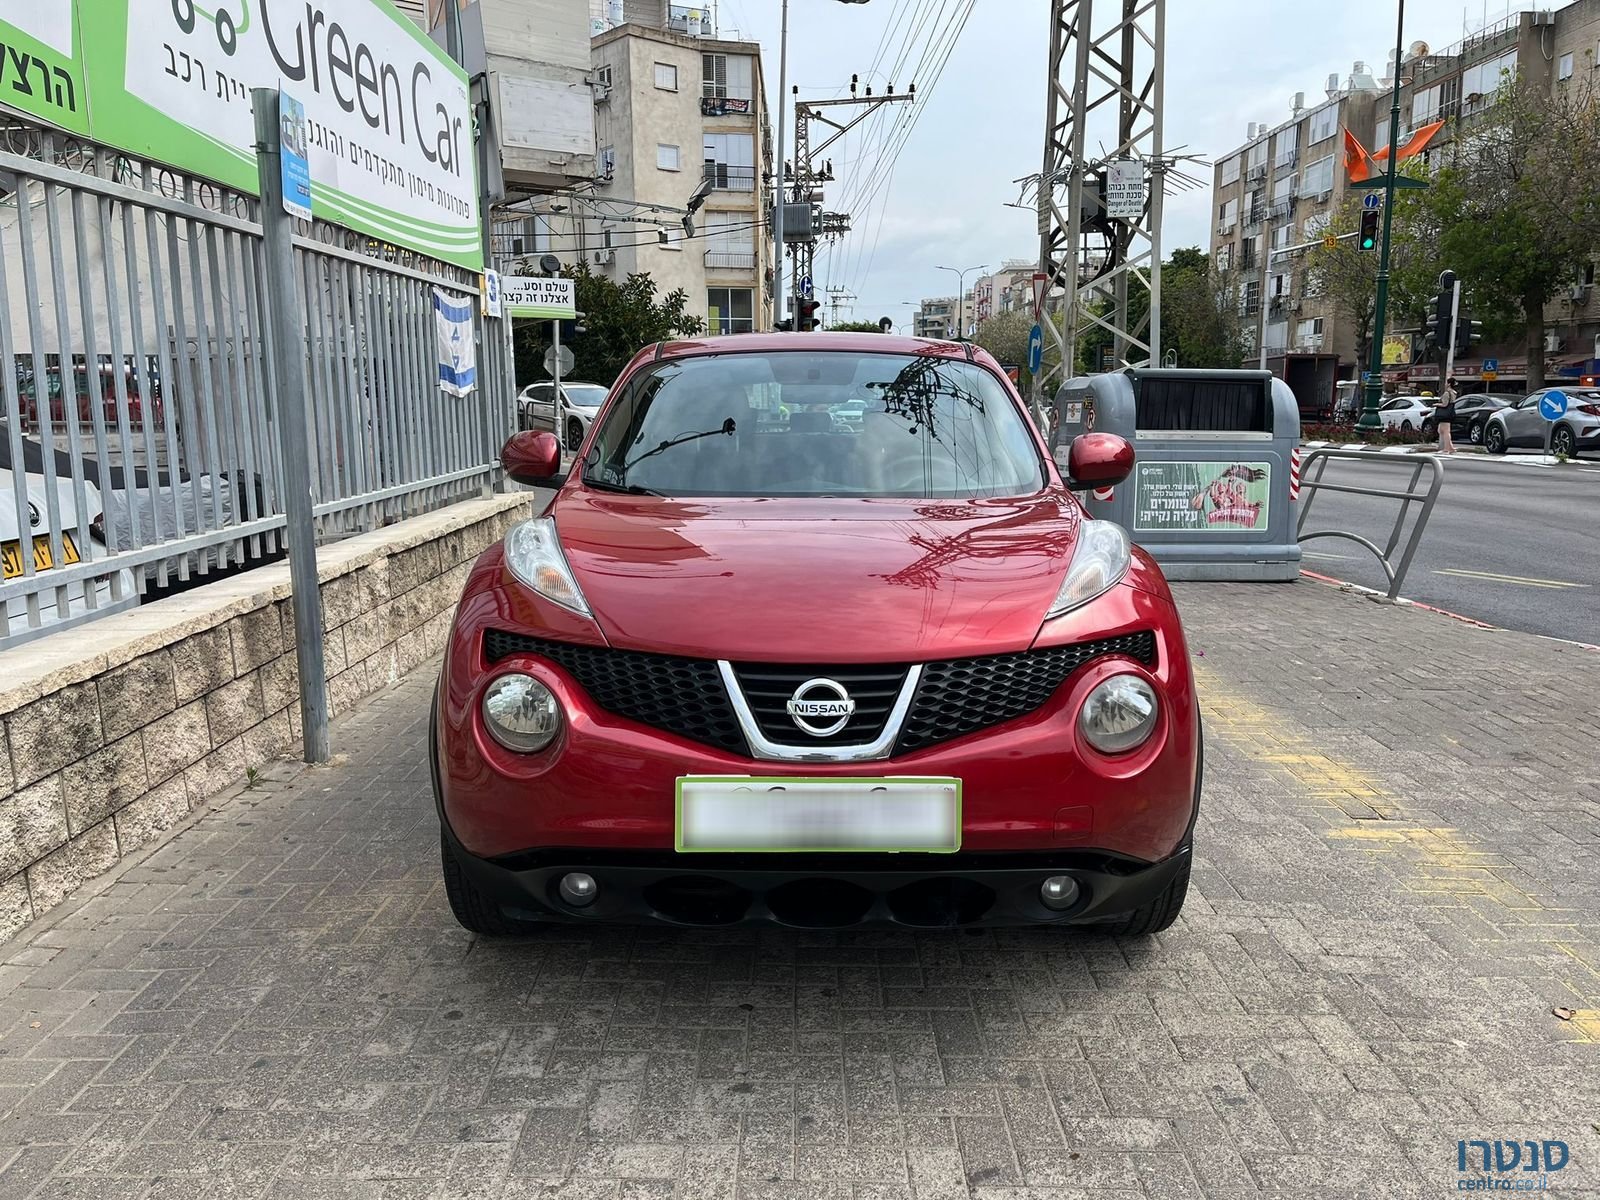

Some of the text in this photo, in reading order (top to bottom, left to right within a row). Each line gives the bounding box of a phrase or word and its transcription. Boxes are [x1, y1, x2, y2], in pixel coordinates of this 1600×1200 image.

[163, 43, 206, 91] רכב
[216, 70, 252, 102] יית
[411, 61, 462, 177] Car
[308, 119, 344, 158] והוגנ
[350, 141, 405, 188] מתקדמים
[408, 172, 434, 202] מימון
[437, 188, 470, 219] פתרונות
[1325, 237, 1335, 247] 13
[513, 281, 568, 292] שלם וסע...
[503, 292, 569, 304] אצלנו זה קצר
[1150, 498, 1189, 509] שומרים
[1140, 510, 1171, 523] נקייה!
[1173, 509, 1198, 522] עליה
[794, 703, 848, 713] NISSAN
